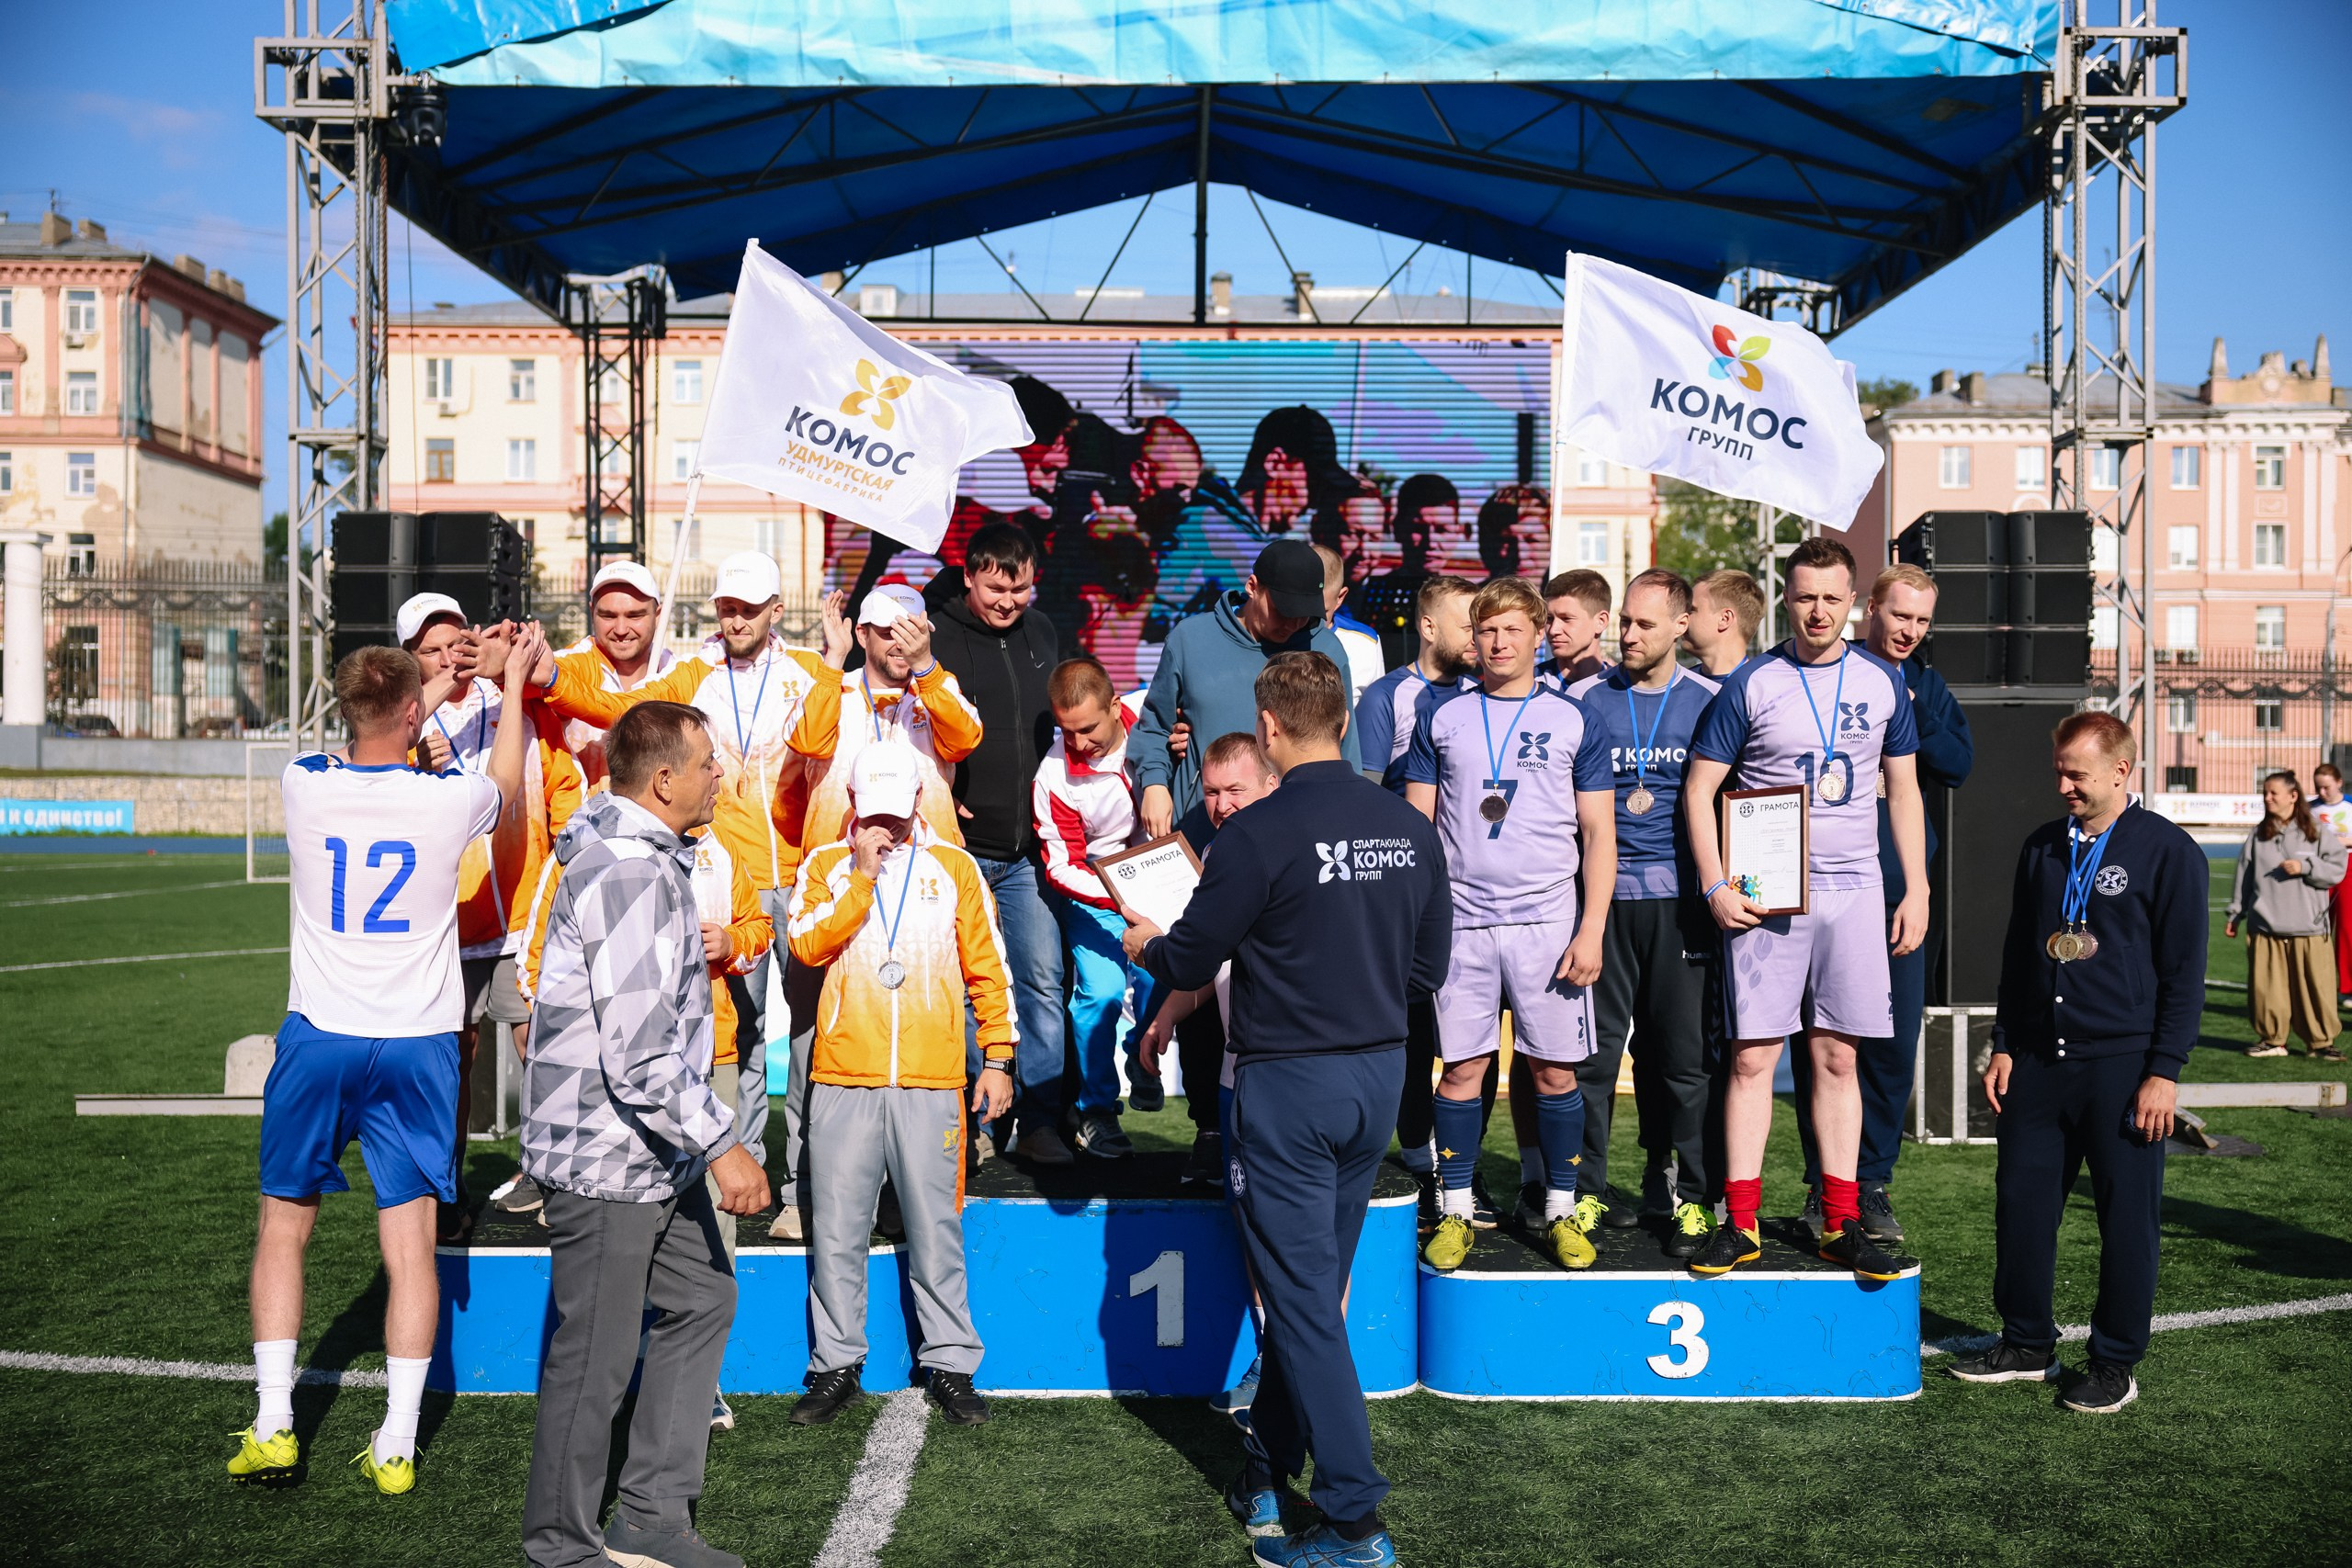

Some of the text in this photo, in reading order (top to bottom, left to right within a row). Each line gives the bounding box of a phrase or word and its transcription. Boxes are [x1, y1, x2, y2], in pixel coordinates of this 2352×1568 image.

[1650, 378, 1807, 449] КОМОС
[784, 406, 915, 476] КОМОС
[1687, 426, 1754, 460] ГРУПП
[778, 457, 883, 502] ПТИЦЕФАБРИКА
[786, 439, 894, 491] УДМУРТСКАЯ
[1517, 761, 1548, 770] КОМОС
[1625, 747, 1688, 763] КОМО
[1793, 750, 1854, 807] 10
[1482, 779, 1519, 840] 7
[1760, 801, 1800, 812] ГРАМОТА
[1140, 850, 1183, 869] ГРАМОТА
[1352, 838, 1412, 850] СПАРТАКИАДА
[1353, 850, 1416, 869] КОМОС
[325, 837, 416, 933] 12
[1355, 870, 1382, 881] ГРУПП
[1128, 1249, 1185, 1348] 1
[1645, 1300, 1710, 1380] 3
